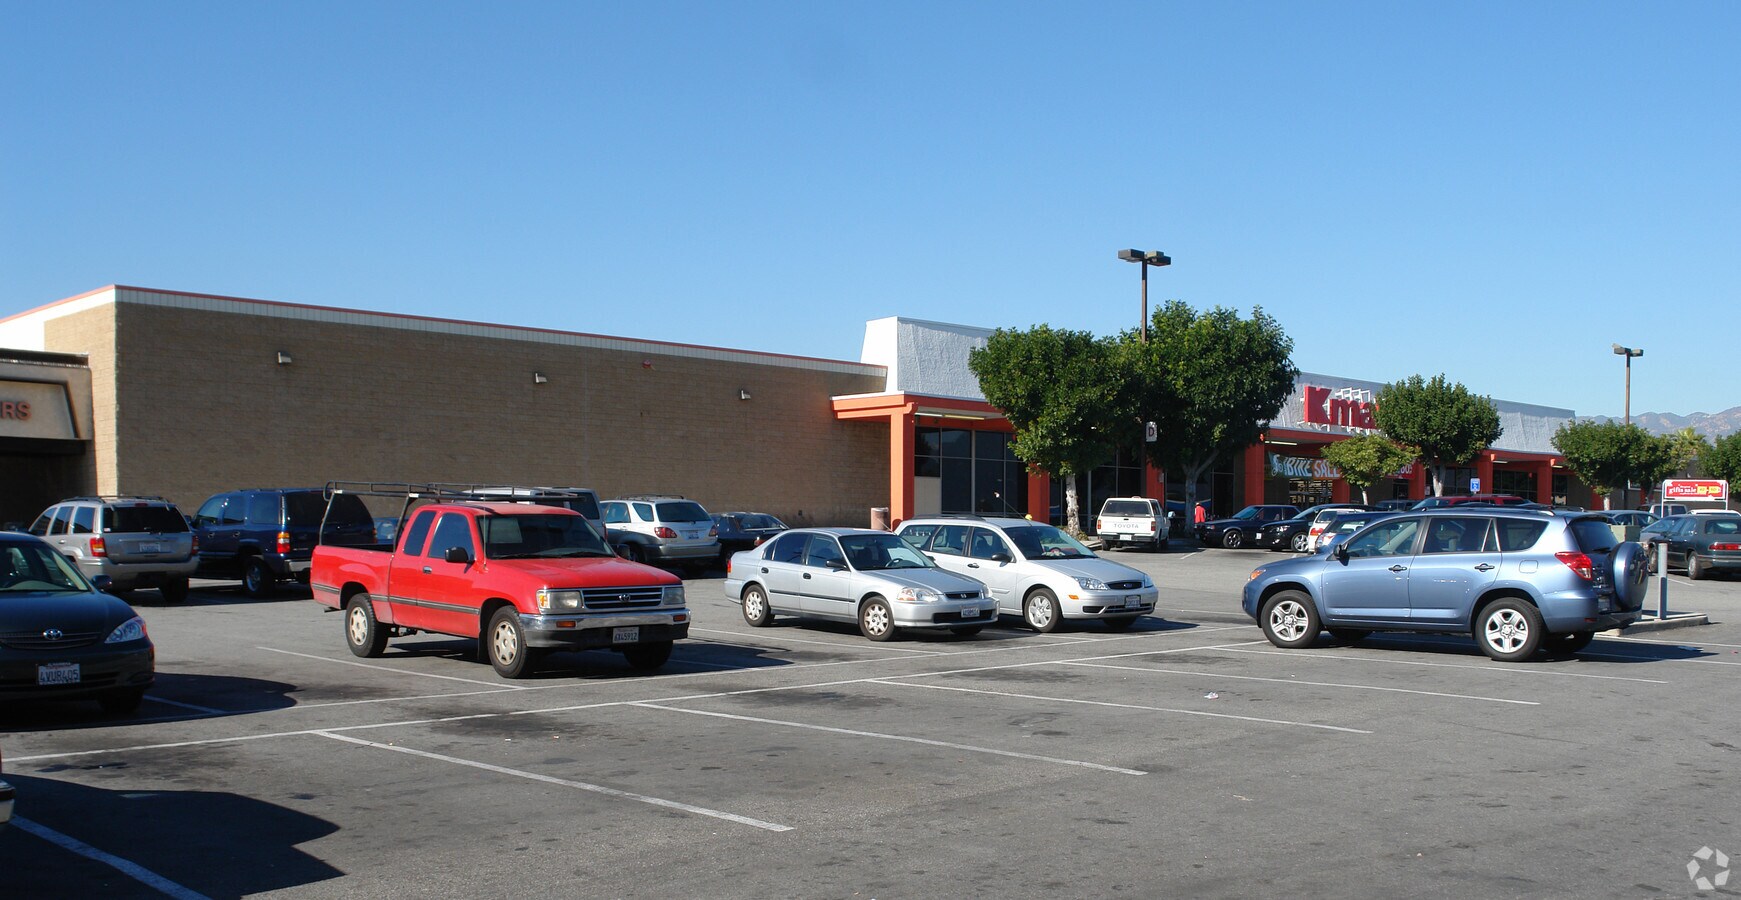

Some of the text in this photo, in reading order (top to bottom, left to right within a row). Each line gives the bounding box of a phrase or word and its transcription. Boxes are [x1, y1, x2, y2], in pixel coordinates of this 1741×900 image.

[1304, 386, 1380, 430] Kma
[1148, 427, 1155, 437] D
[1285, 457, 1313, 477] BIKE
